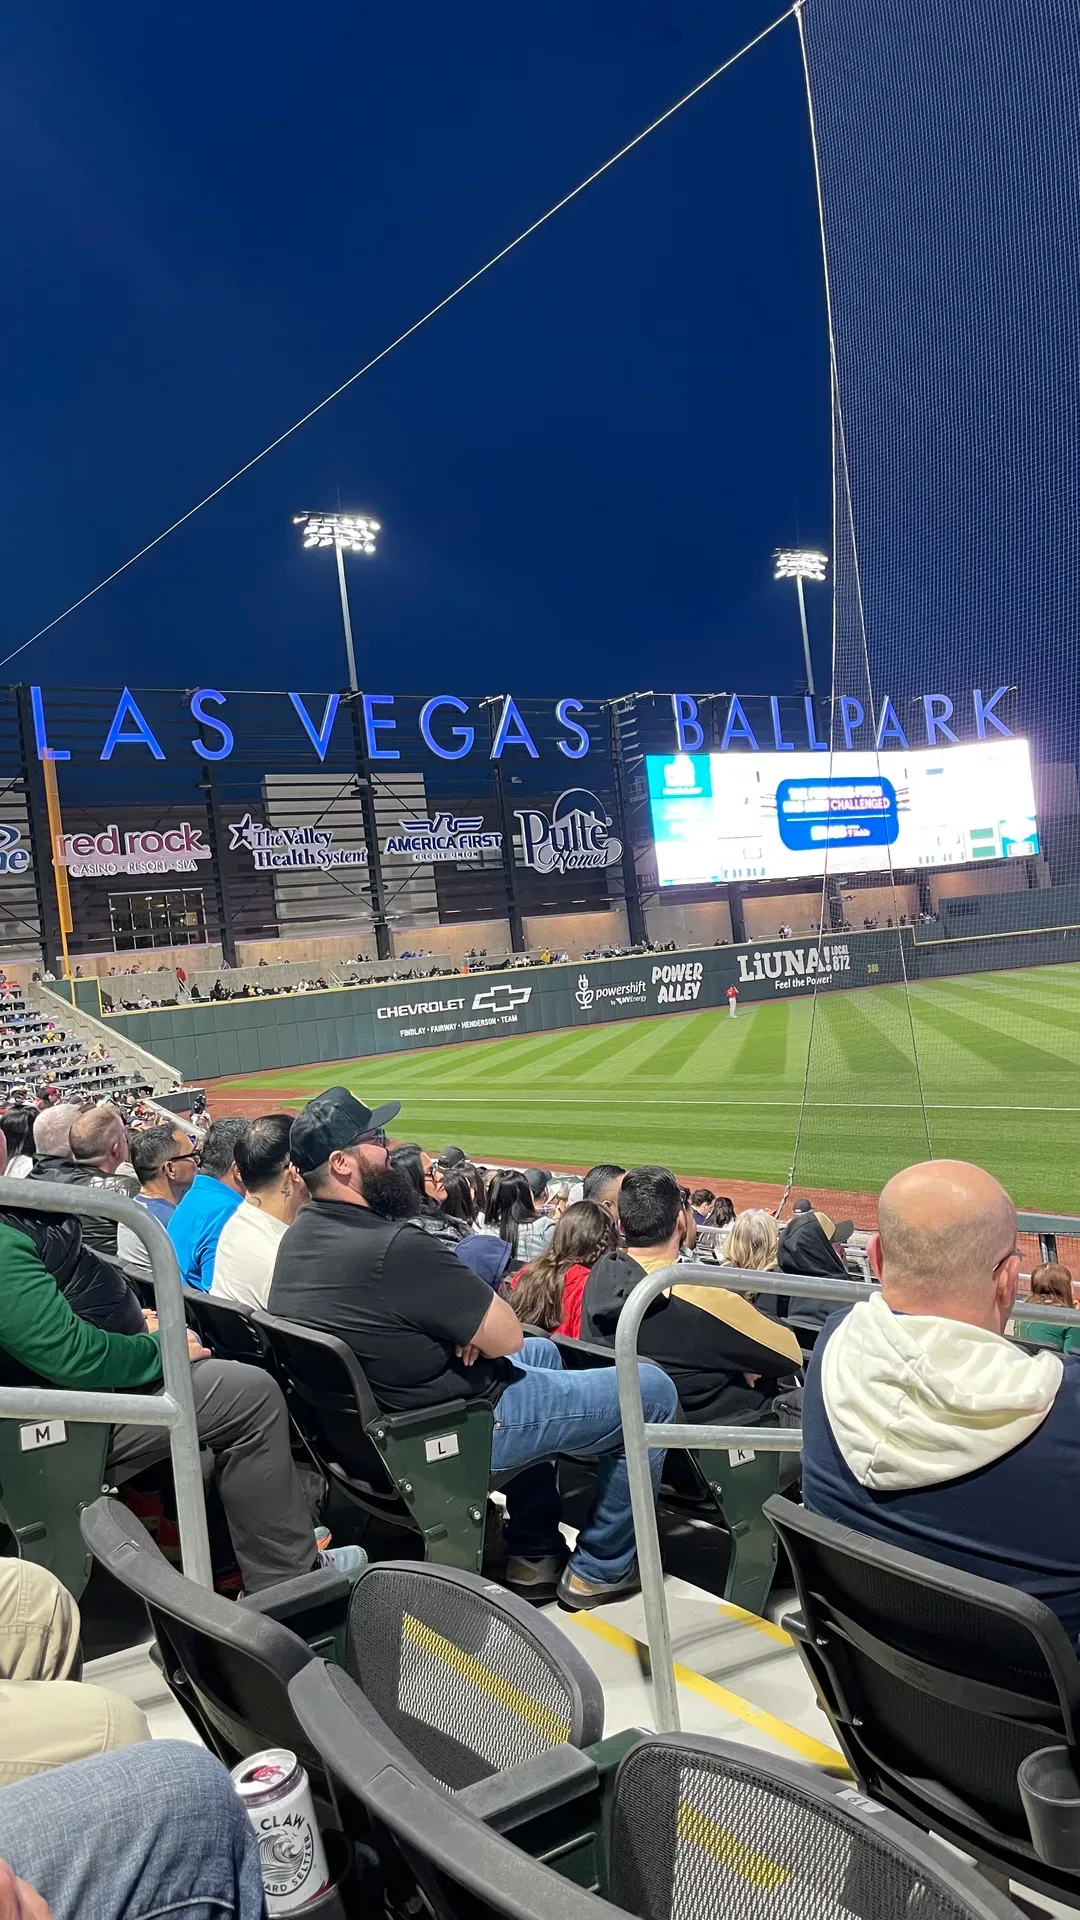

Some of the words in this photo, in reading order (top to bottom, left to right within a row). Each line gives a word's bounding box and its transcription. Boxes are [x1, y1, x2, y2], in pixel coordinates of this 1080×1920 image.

[30, 686, 234, 760] LAS
[288, 693, 590, 761] VEGAS
[672, 686, 1015, 751] BALLPARK
[830, 797, 890, 811] CHALLENGED
[59, 828, 119, 857] red
[128, 825, 206, 853] rock
[254, 831, 283, 846] The
[282, 828, 332, 847] Valley
[386, 836, 456, 852] AMERICA
[460, 834, 502, 849] FIRST
[514, 810, 608, 865] Pulte
[255, 849, 315, 867] Health
[316, 849, 366, 868] System
[415, 852, 447, 860] CREDIT
[451, 850, 478, 858] UNION
[540, 843, 614, 873] Homes
[72, 863, 117, 875] CASINO
[128, 860, 168, 873] RESORT
[176, 858, 197, 871] SPA
[831, 945, 850, 956] LOCAL
[736, 946, 832, 982] LiUNA!
[832, 955, 851, 972] 872
[651, 962, 703, 985] POWER
[775, 979, 791, 989] Feel
[792, 977, 805, 988] the
[806, 974, 832, 986] Power!
[596, 981, 647, 1000] powershift
[657, 981, 701, 1004] ALLEY
[377, 998, 465, 1019] CHEVROLET
[400, 1027, 425, 1037] FINDLAY
[430, 1023, 457, 1033] FAIRWAY
[461, 1019, 496, 1029] HENDERSON
[500, 1014, 518, 1024] TEAM
[36, 1425, 50, 1443] M
[438, 1441, 447, 1455] L
[737, 1450, 746, 1461] K
[260, 1813, 305, 1830] CLAW
[263, 1882, 288, 1892] ARD
[291, 1834, 311, 1886] SELTZER
